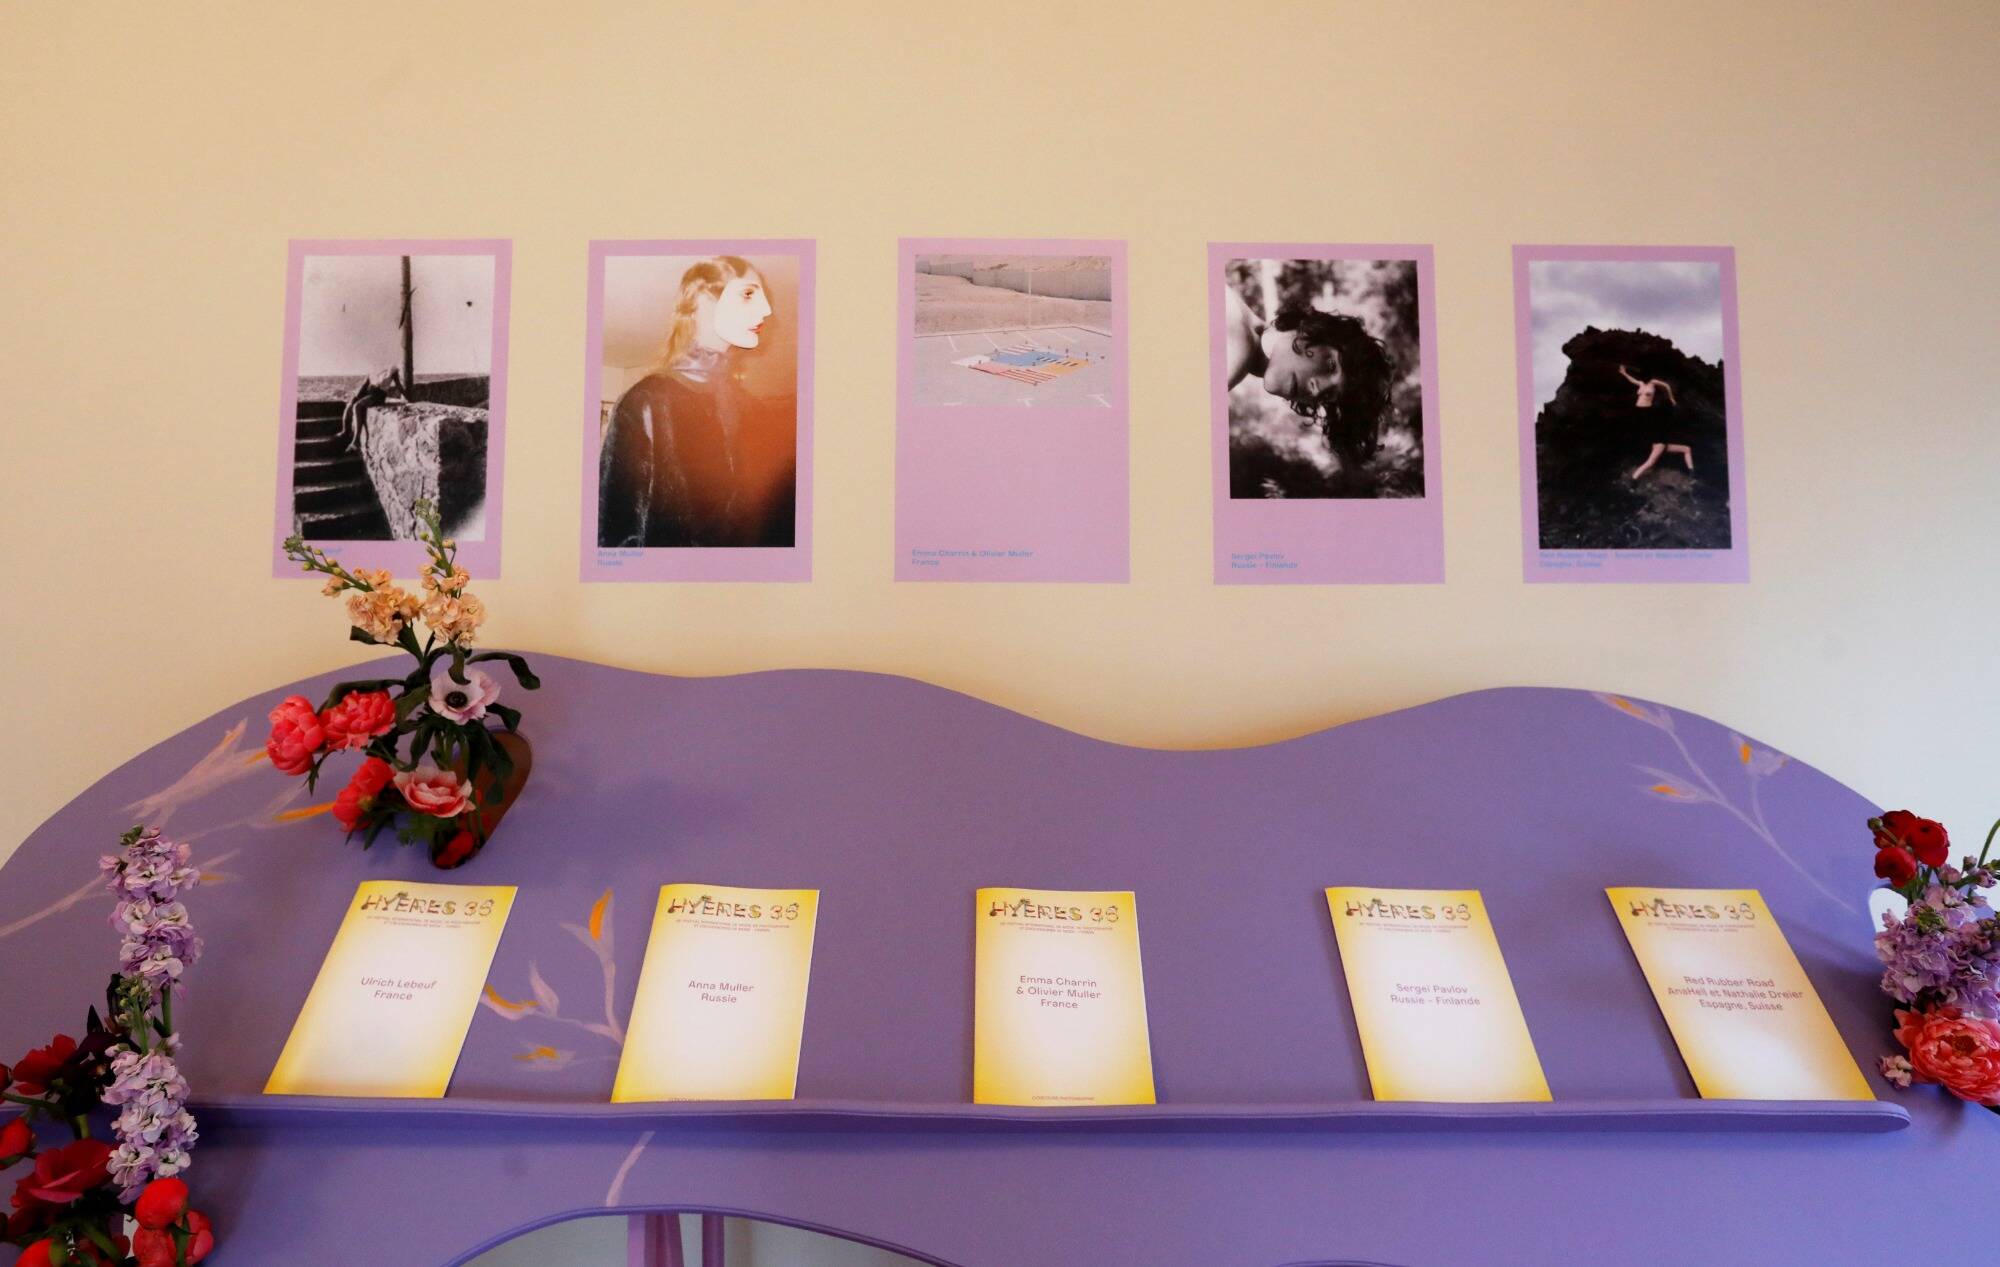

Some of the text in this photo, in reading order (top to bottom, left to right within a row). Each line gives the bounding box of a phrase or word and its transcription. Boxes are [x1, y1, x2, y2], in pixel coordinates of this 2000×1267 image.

[360, 976, 437, 990] Ulrich Lebeuf
[688, 980, 755, 993] Anna Muller
[1019, 975, 1098, 988] Emma Charrin
[1683, 976, 1775, 988] Red Rubber Road
[373, 989, 413, 1001] France
[1016, 986, 1103, 1000] & Olivier Muller
[1395, 983, 1469, 995] Sergei Pavlov
[1709, 989, 1721, 998] et
[1722, 988, 1766, 999] Nathalie
[1769, 990, 1804, 1001] Dreier
[701, 992, 737, 1004] Russie
[1040, 998, 1079, 1009] France
[1390, 994, 1425, 1005] Russie
[1435, 996, 1481, 1006] Finlande
[1749, 1001, 1784, 1012] Suisse
